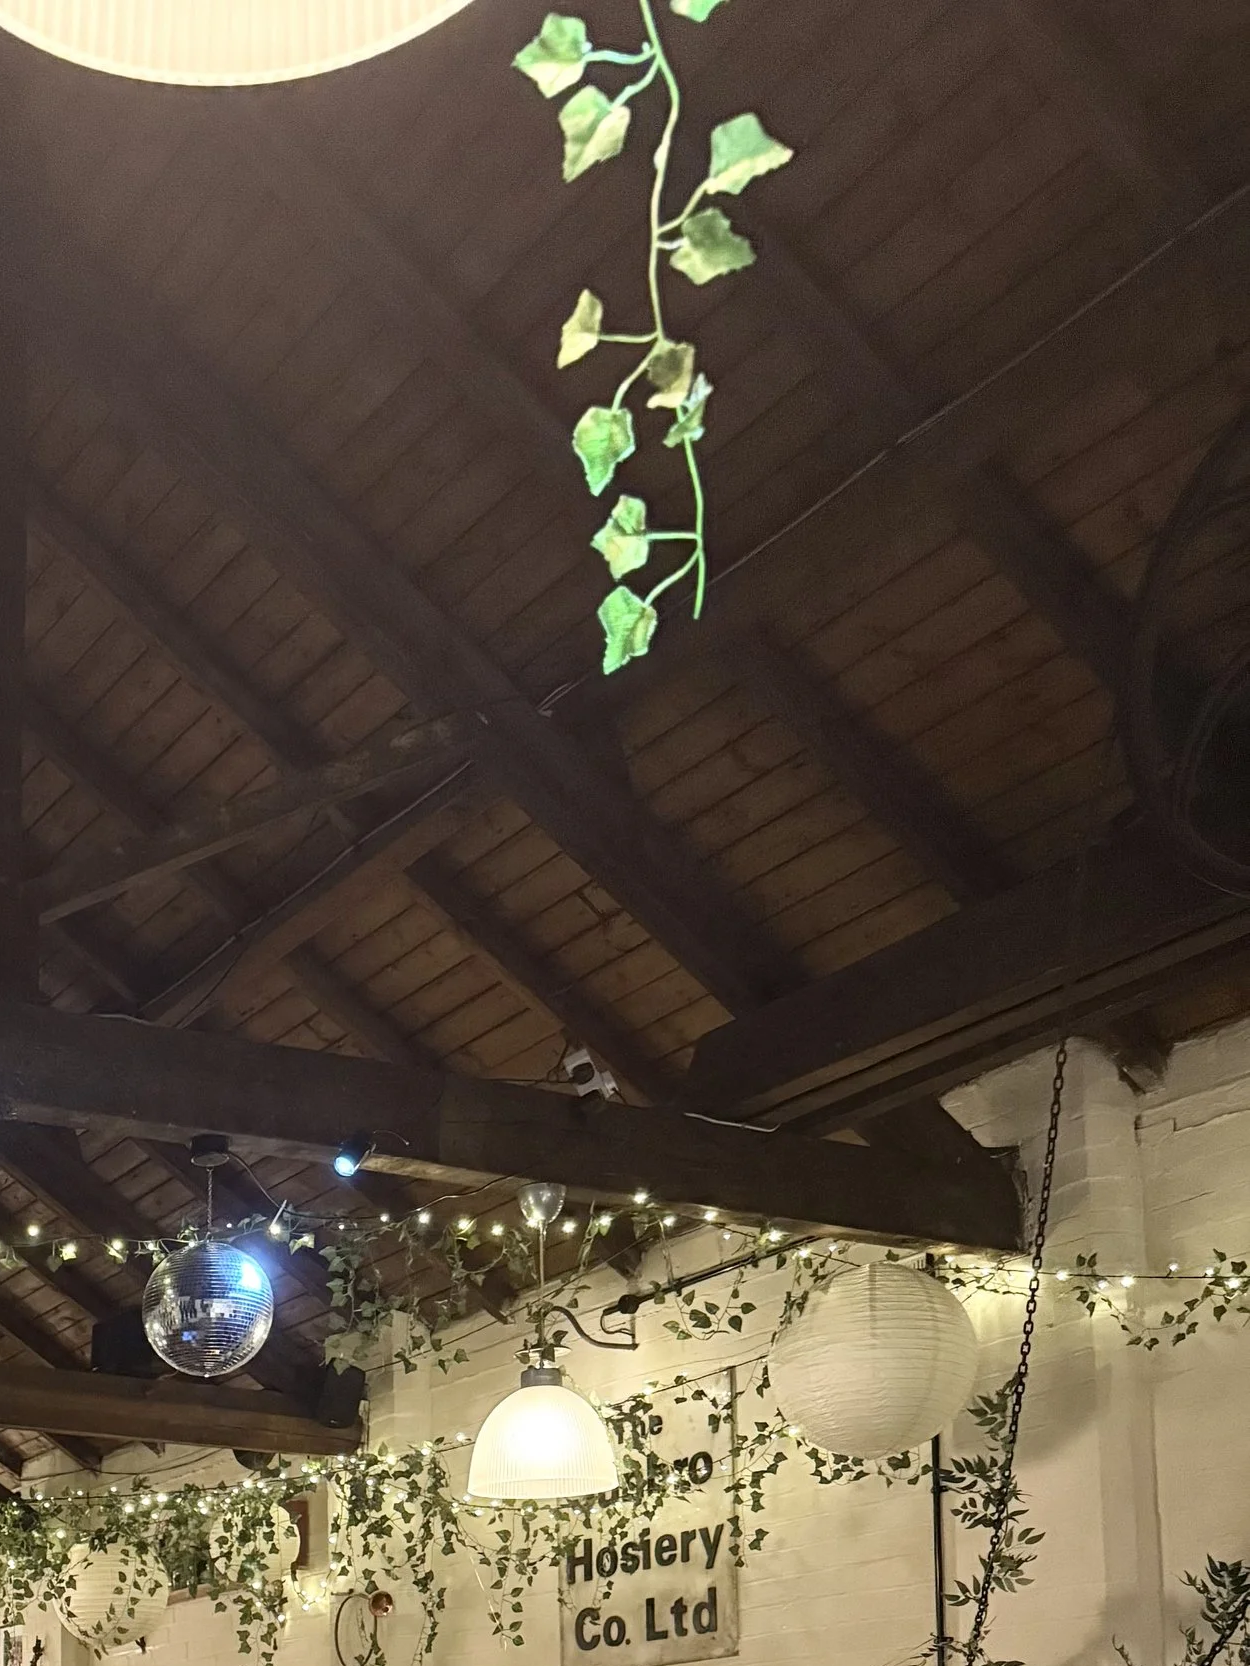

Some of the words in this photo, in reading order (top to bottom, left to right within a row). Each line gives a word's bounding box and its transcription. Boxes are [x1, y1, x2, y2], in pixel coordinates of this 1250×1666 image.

[567, 1524, 723, 1585] Hosiery
[575, 1606, 631, 1650] Co.
[646, 1587, 717, 1641] Ltd
